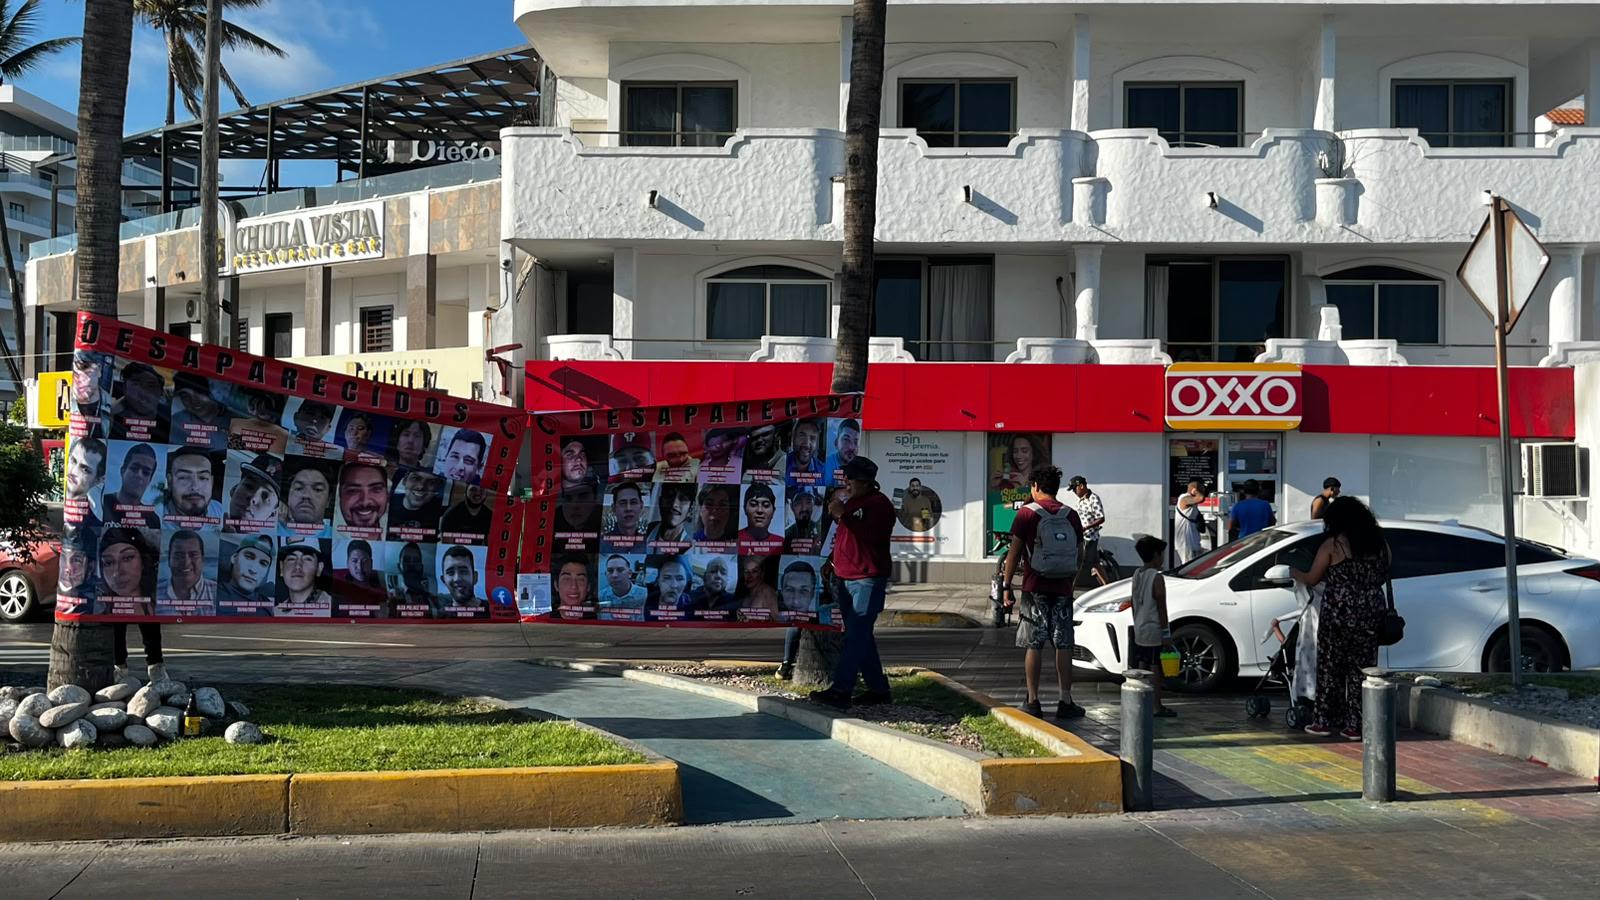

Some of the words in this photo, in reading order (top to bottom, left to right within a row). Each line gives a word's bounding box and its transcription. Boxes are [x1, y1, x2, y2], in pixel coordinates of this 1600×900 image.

[410, 139, 495, 164] Diego
[235, 218, 308, 254] CHULA
[309, 208, 381, 246] VISTA
[80, 318, 470, 423] DESAPARECIDOS
[1171, 377, 1297, 415] OXXO
[895, 434, 920, 446] spin
